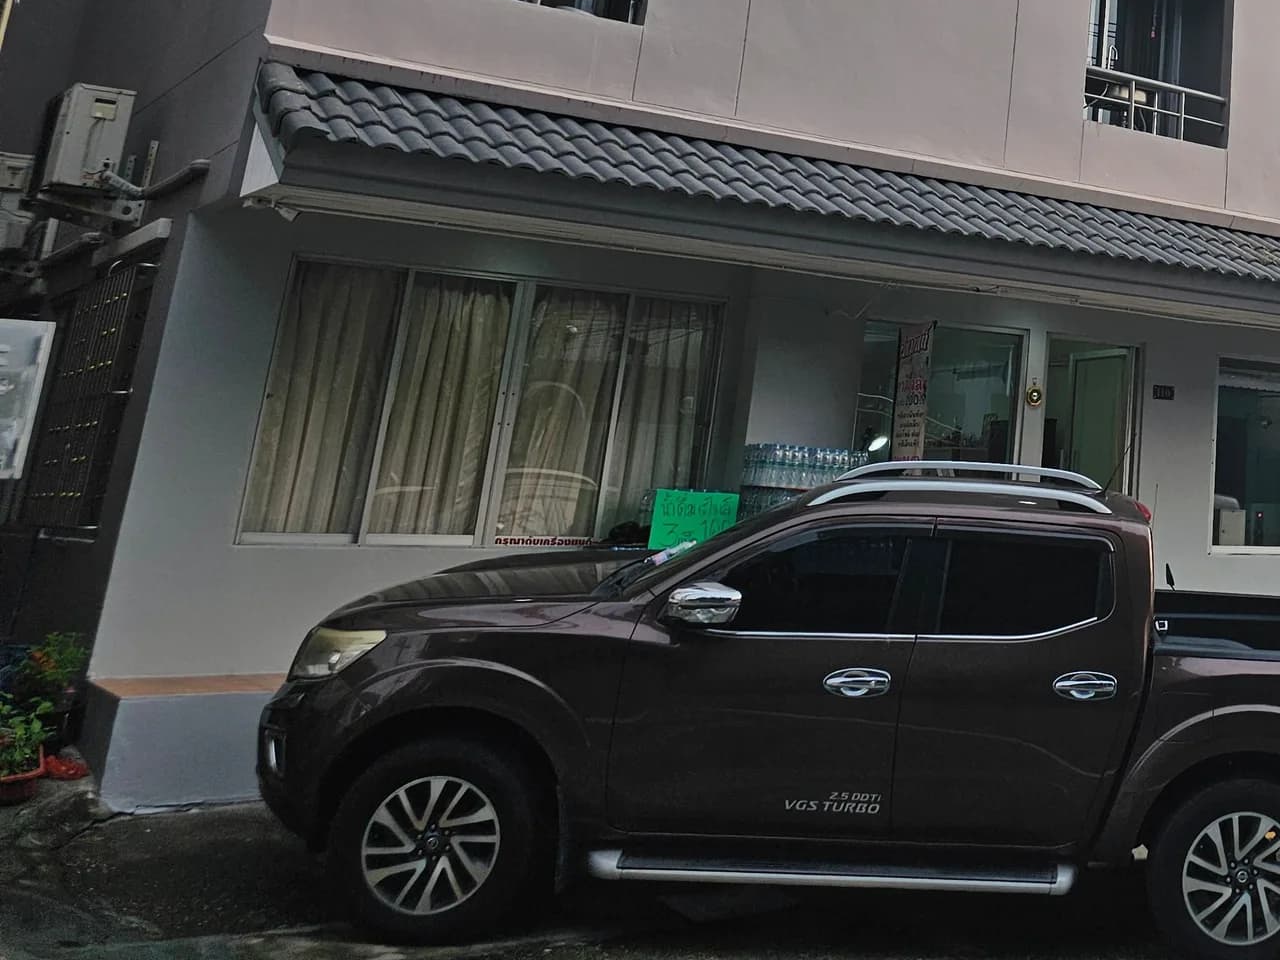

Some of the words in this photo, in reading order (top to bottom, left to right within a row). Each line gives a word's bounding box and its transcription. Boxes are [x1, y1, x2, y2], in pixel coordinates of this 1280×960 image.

[829, 791, 849, 801] 2.5
[784, 799, 819, 811] VGS
[822, 801, 880, 814] TURBO
